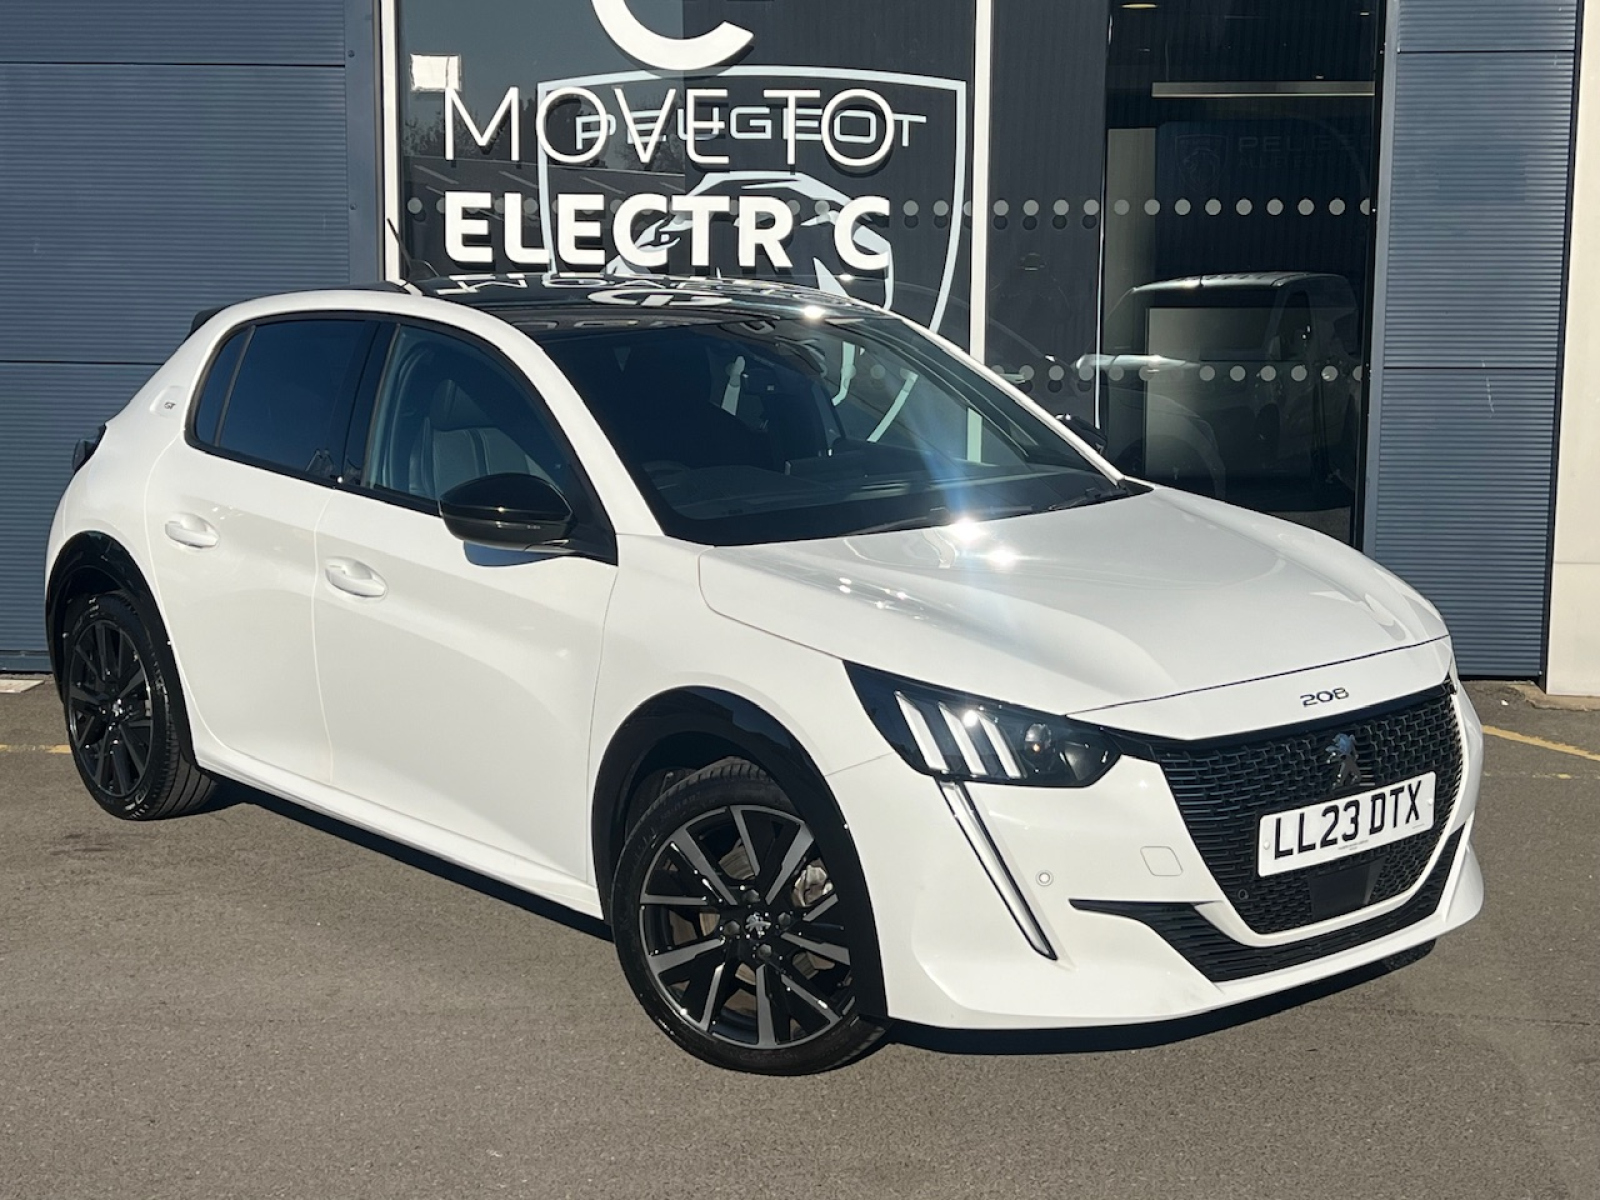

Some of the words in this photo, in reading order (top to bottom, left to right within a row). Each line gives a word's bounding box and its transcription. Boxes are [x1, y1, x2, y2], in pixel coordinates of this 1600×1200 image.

[444, 85, 730, 165] MOVE
[763, 88, 895, 167] TO
[575, 106, 927, 150] PEUGEOT
[1299, 687, 1350, 707] 208
[1274, 799, 1361, 860] LL23
[1368, 780, 1422, 836] DTX
